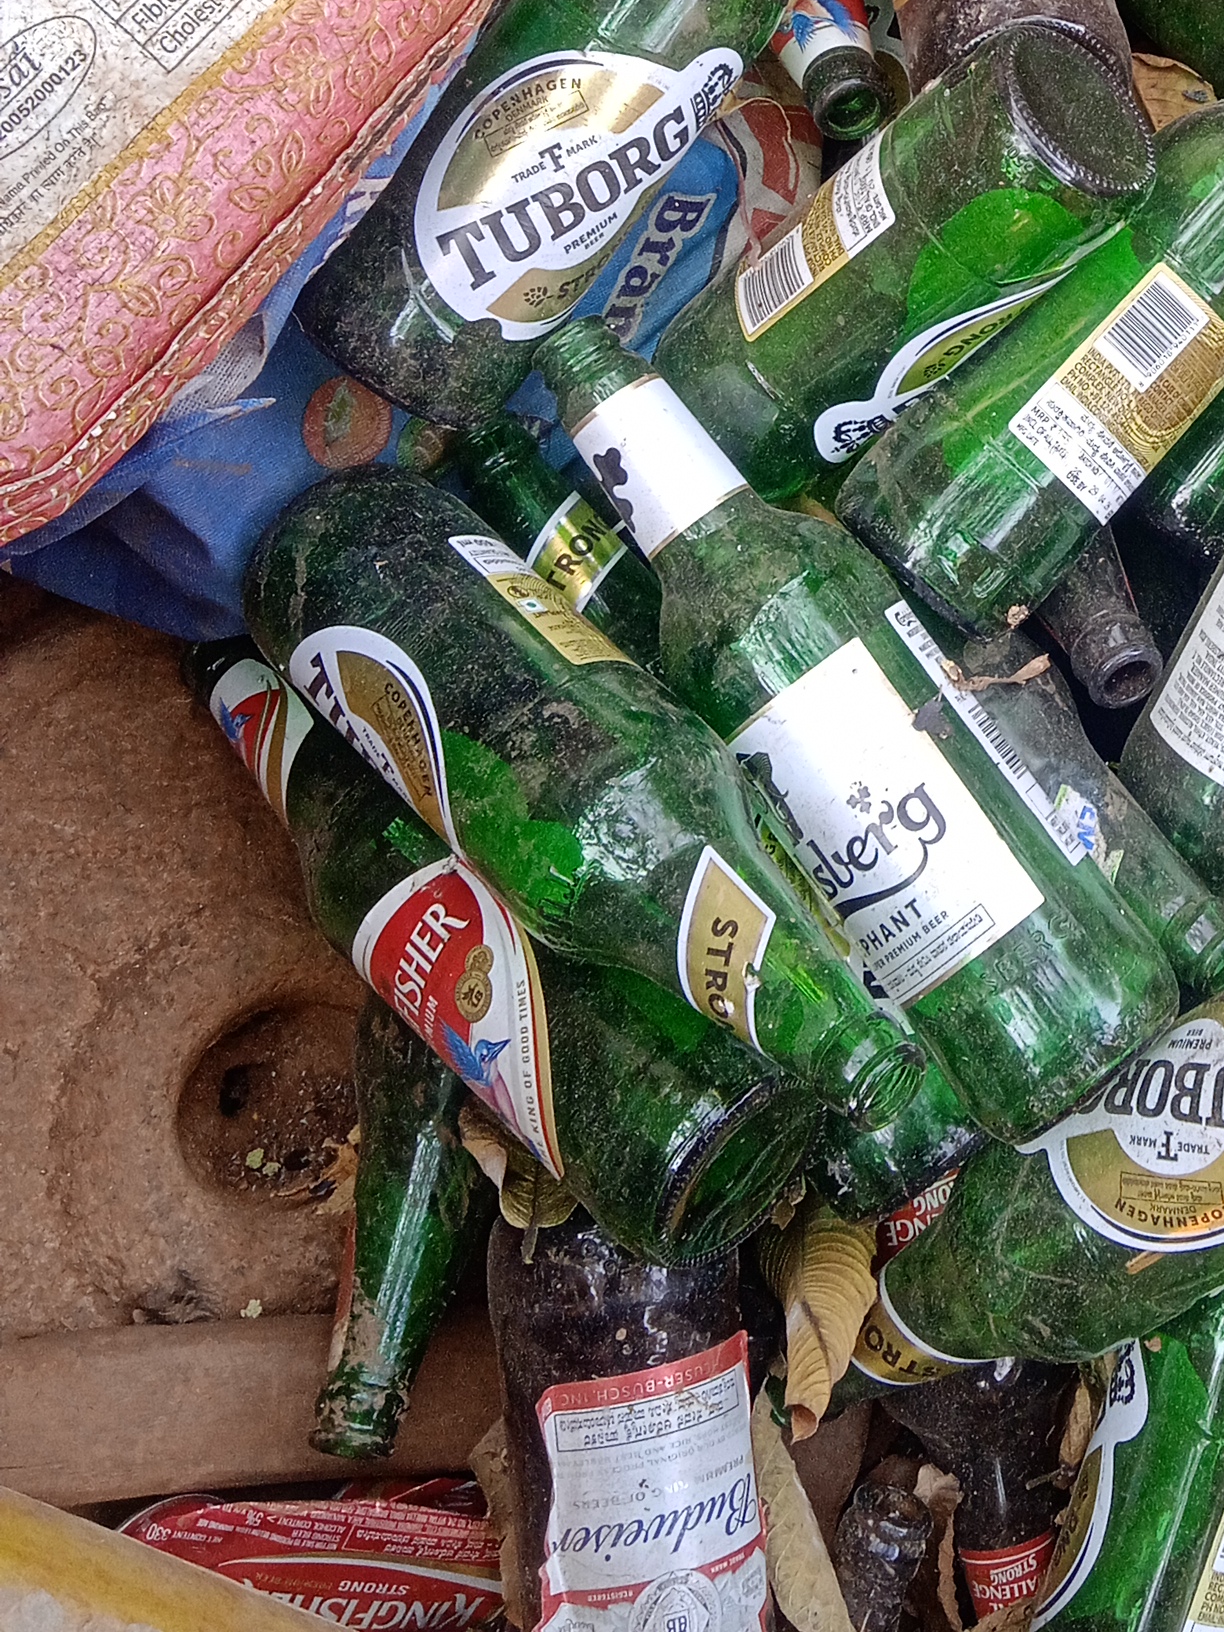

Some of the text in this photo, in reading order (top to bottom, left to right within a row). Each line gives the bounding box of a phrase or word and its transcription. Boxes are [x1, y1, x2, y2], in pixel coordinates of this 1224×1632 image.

[473, 78, 581, 140] COPENHAGEN
[503, 93, 549, 122] DENMARK
[511, 134, 598, 184] TRADE MARK
[435, 103, 691, 291] TUBORG
[563, 211, 618, 254] PREMIUM
[583, 232, 605, 249] BEER
[1087, 348, 1107, 366] INDIA
[1066, 369, 1079, 380] PH
[1081, 356, 1116, 392] RECTANGLE
[1031, 406, 1048, 424] MRP
[545, 511, 612, 592] TRON
[384, 683, 432, 795] COPENHAGEN
[884, 909, 948, 962] PREMIUM BEER
[517, 979, 538, 1131] KING OF GOOD TIMES
[1167, 1038, 1211, 1048] PREMIUM
[1128, 1134, 1210, 1155] TRADE MARK
[1150, 1203, 1196, 1215] DENMARK
[146, 1523, 205, 1540] CONTENT 330
[552, 1473, 757, 1563] Budweiser
[990, 1554, 1037, 1586] STRONG
[338, 1579, 408, 1594] STRONG
